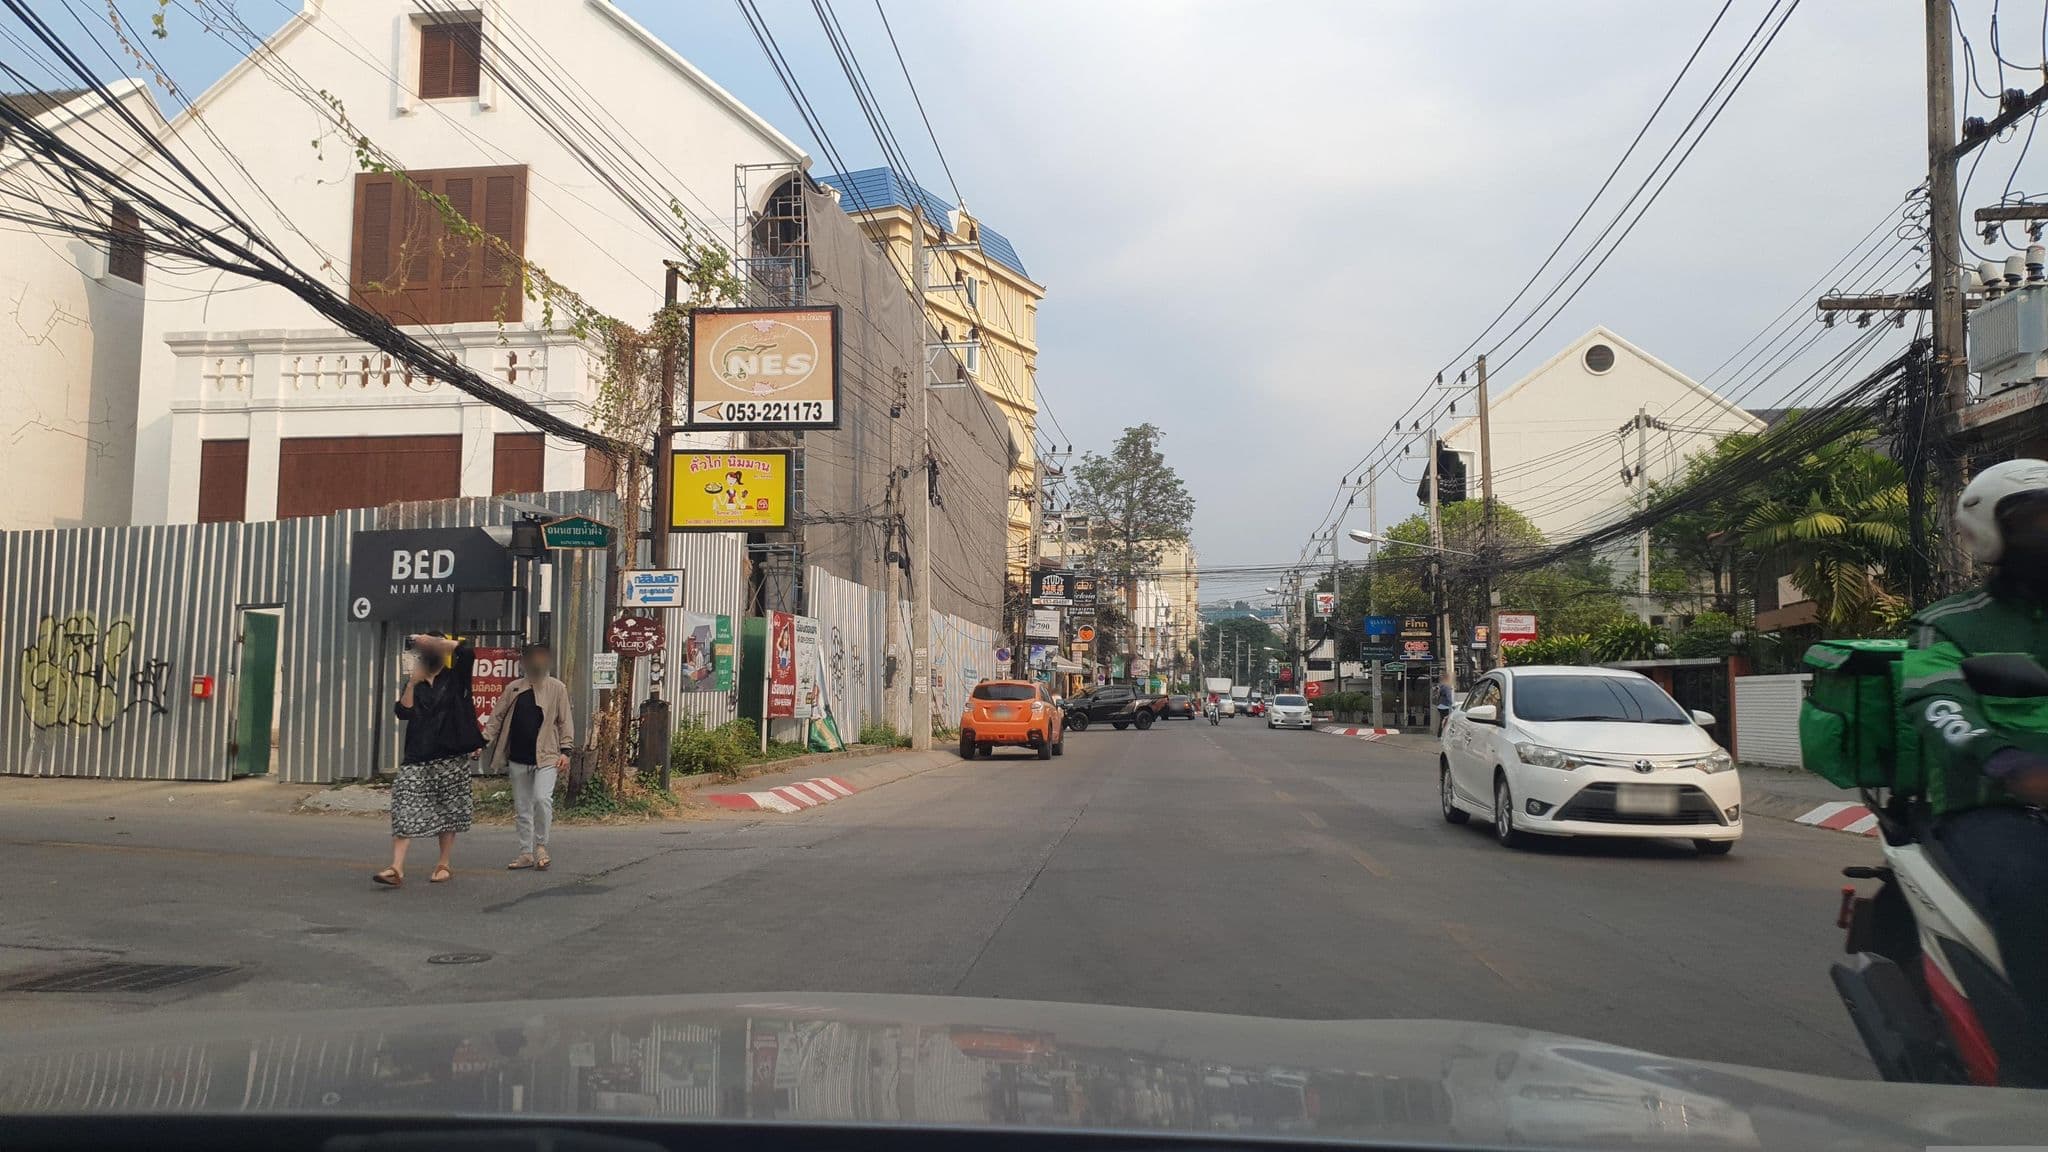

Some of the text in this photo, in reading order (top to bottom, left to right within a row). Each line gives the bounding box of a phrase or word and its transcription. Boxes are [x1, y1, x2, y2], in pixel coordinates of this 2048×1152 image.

[727, 353, 812, 376] NES
[726, 402, 822, 421] 053-221173
[690, 455, 770, 473] คั่วไก่ นิมมาน
[391, 549, 455, 580] BED
[390, 583, 455, 594] NIMMAN
[1042, 574, 1065, 585] STUDY
[1405, 619, 1428, 628] Finn
